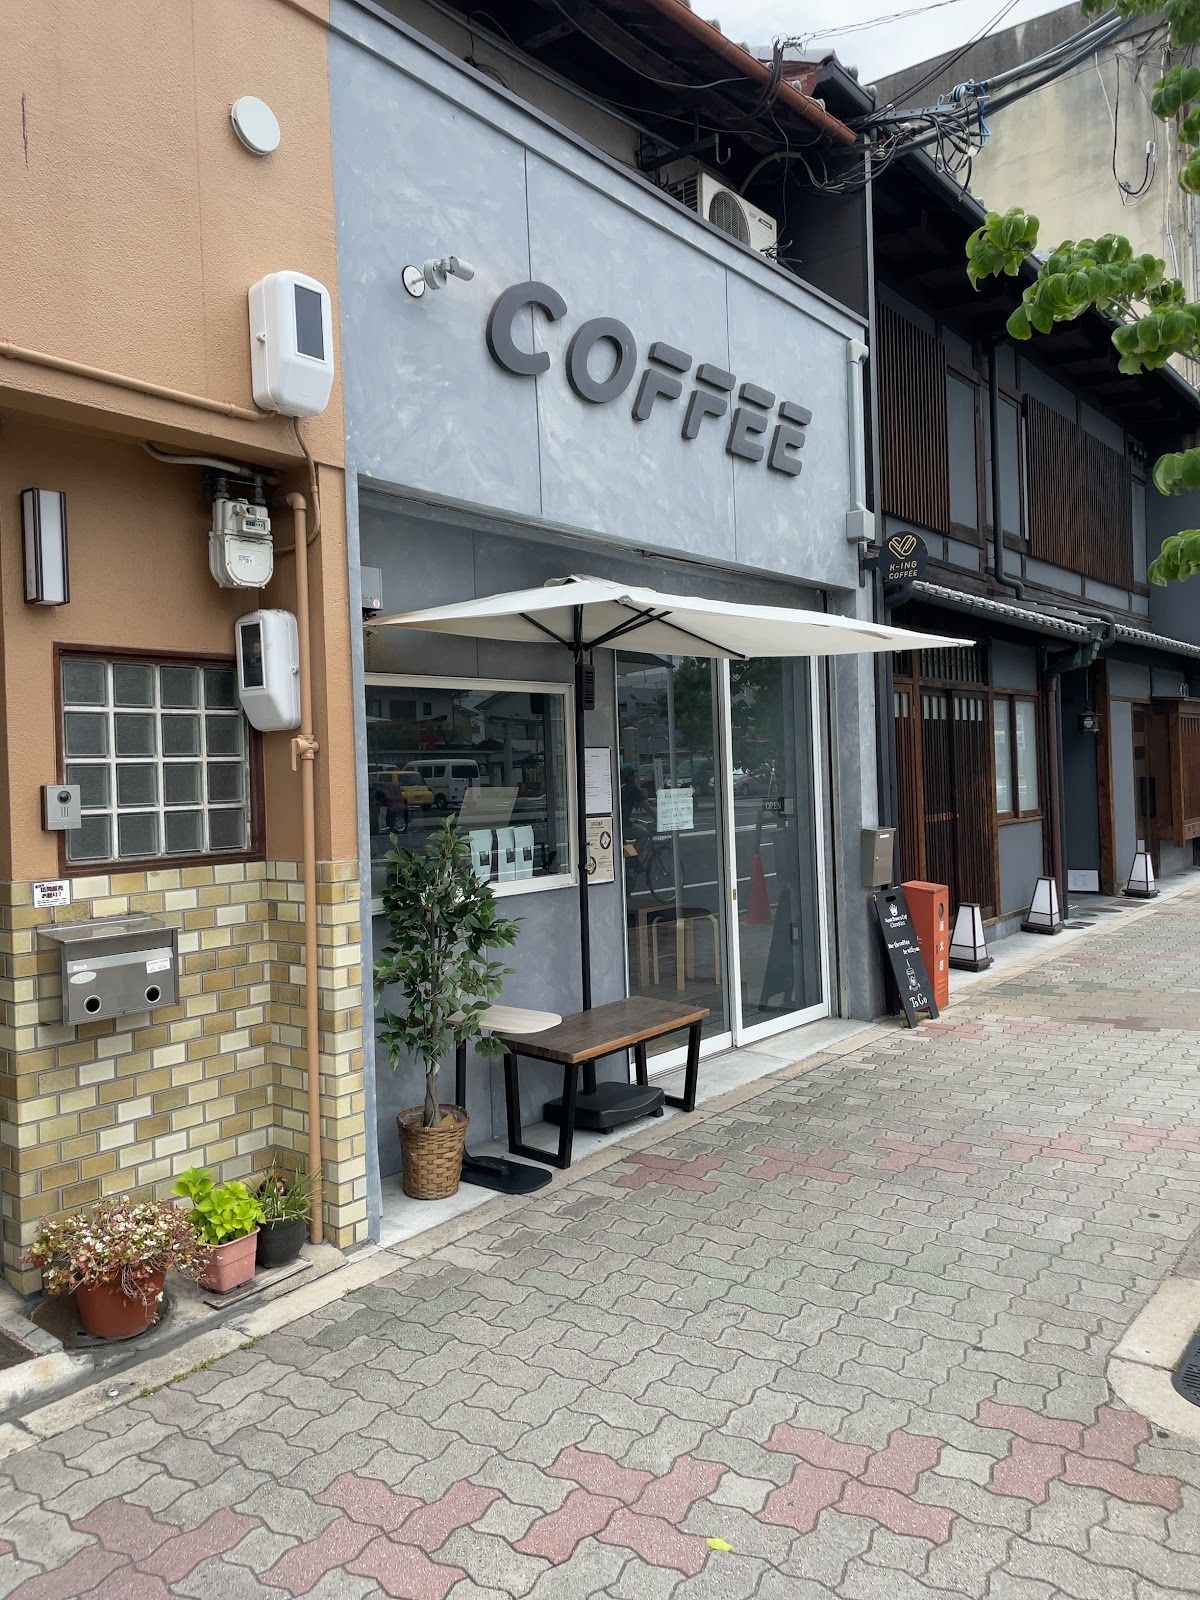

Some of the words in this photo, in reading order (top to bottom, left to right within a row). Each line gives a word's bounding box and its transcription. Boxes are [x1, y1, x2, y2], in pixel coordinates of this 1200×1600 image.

[486, 280, 813, 477] COFFEE
[889, 561, 917, 571] K-ING
[889, 570, 918, 580] COFFEE
[765, 801, 782, 810] OPEN
[909, 996, 919, 1008] To
